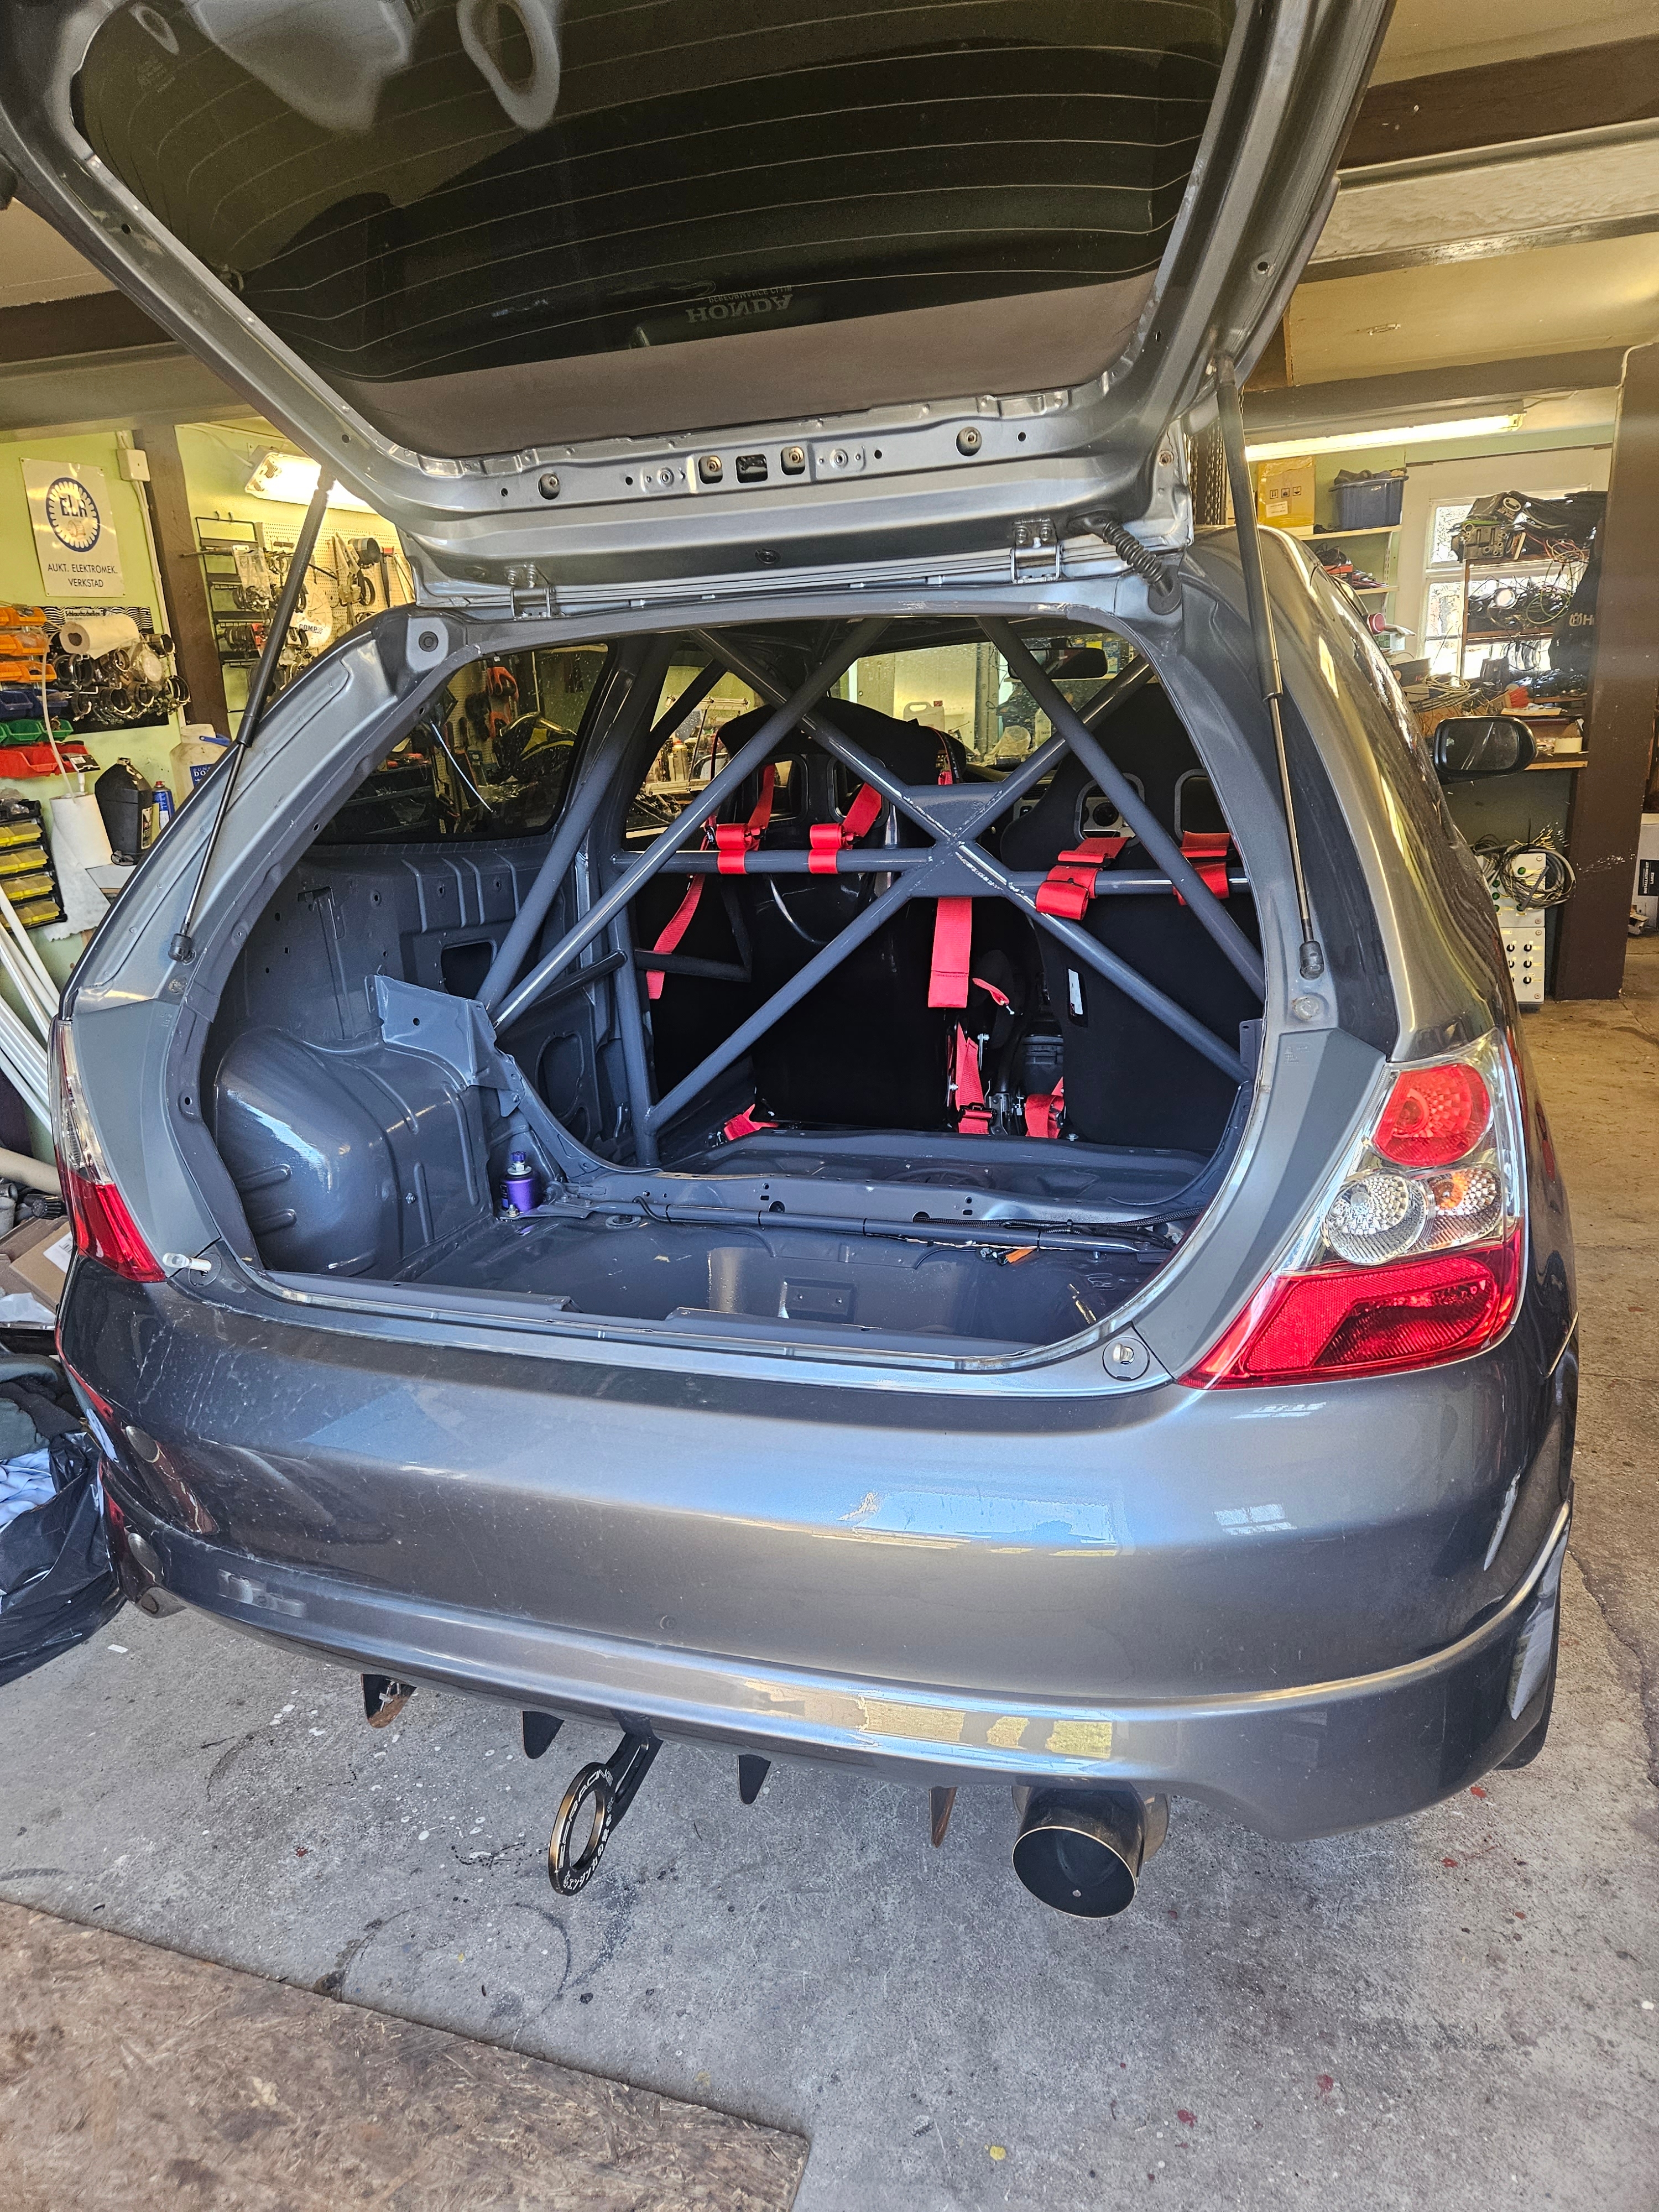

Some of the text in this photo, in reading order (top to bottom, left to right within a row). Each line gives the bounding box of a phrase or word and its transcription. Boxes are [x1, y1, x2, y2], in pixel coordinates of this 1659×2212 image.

[48, 563, 118, 574] AUKT. ELEKTROMEK.
[67, 578, 104, 588] VERKSTAD
[299, 623, 318, 632] COMP
